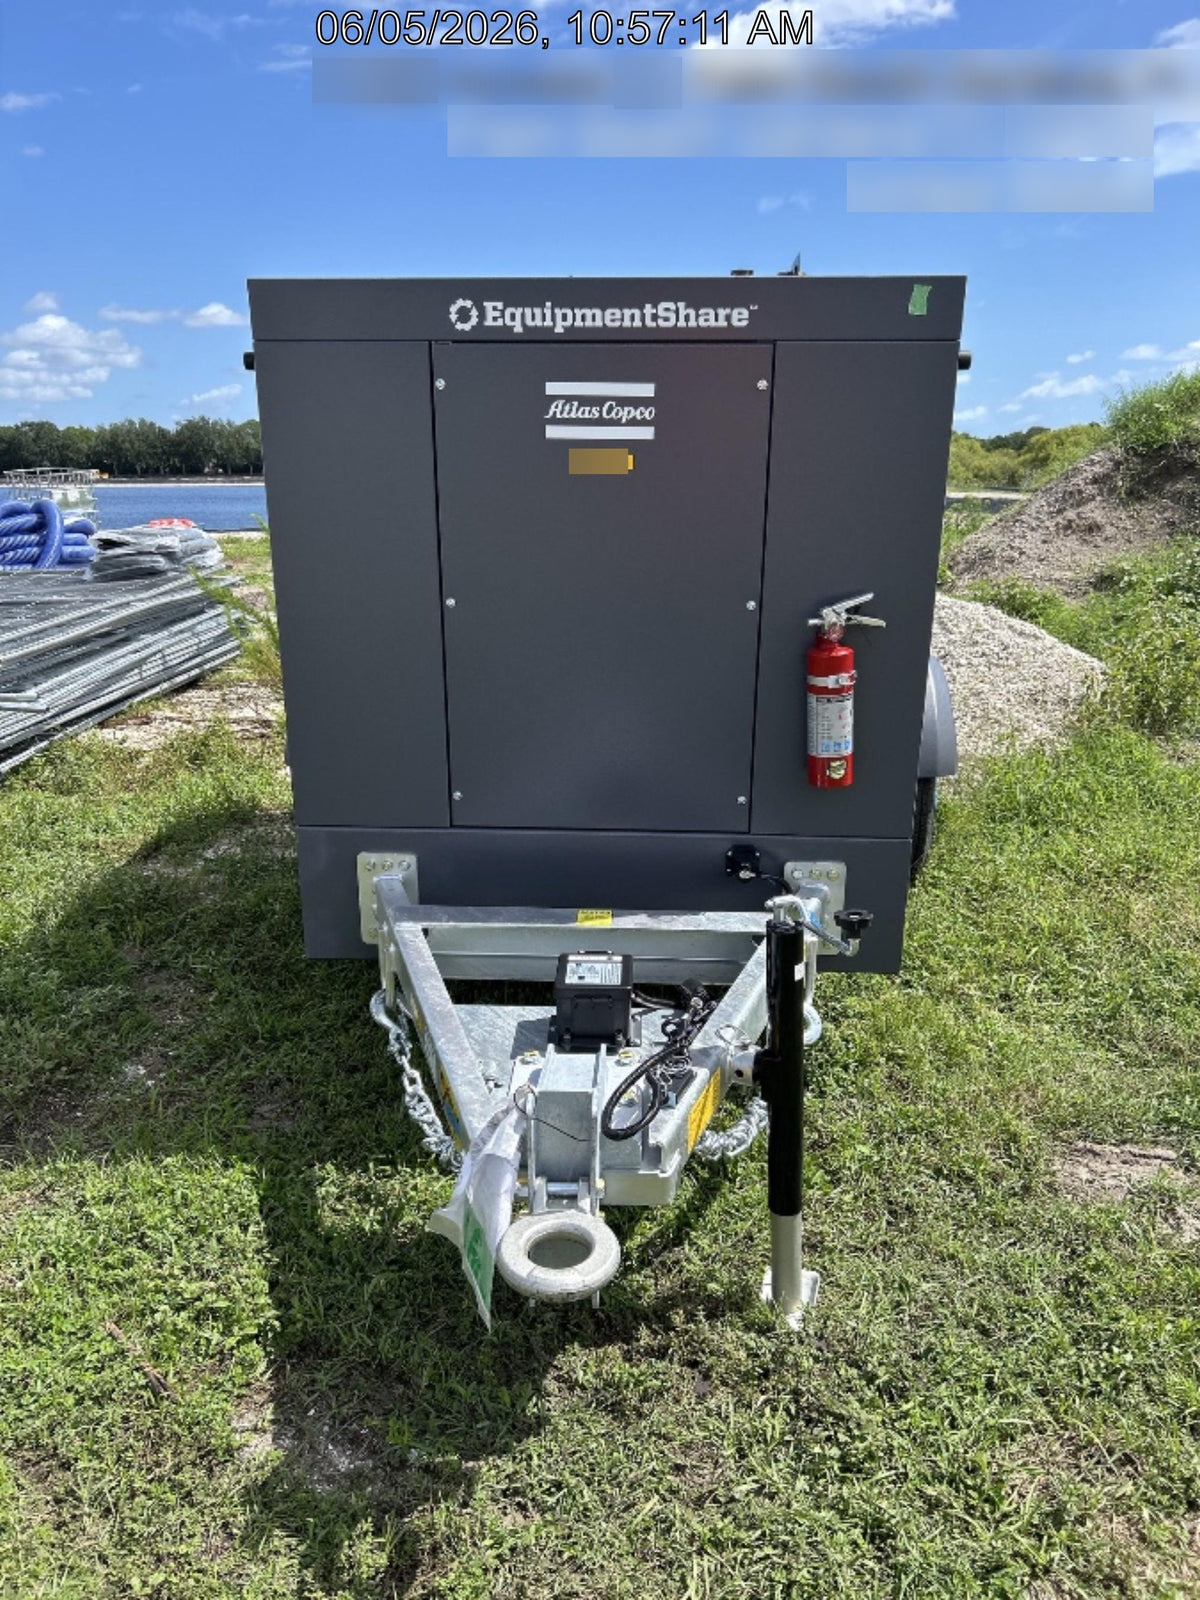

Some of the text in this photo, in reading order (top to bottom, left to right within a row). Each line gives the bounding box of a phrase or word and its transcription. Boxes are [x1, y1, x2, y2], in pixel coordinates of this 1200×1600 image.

[483, 301, 750, 333] EquipmentShare
[545, 400, 655, 423] Atlas Copco
